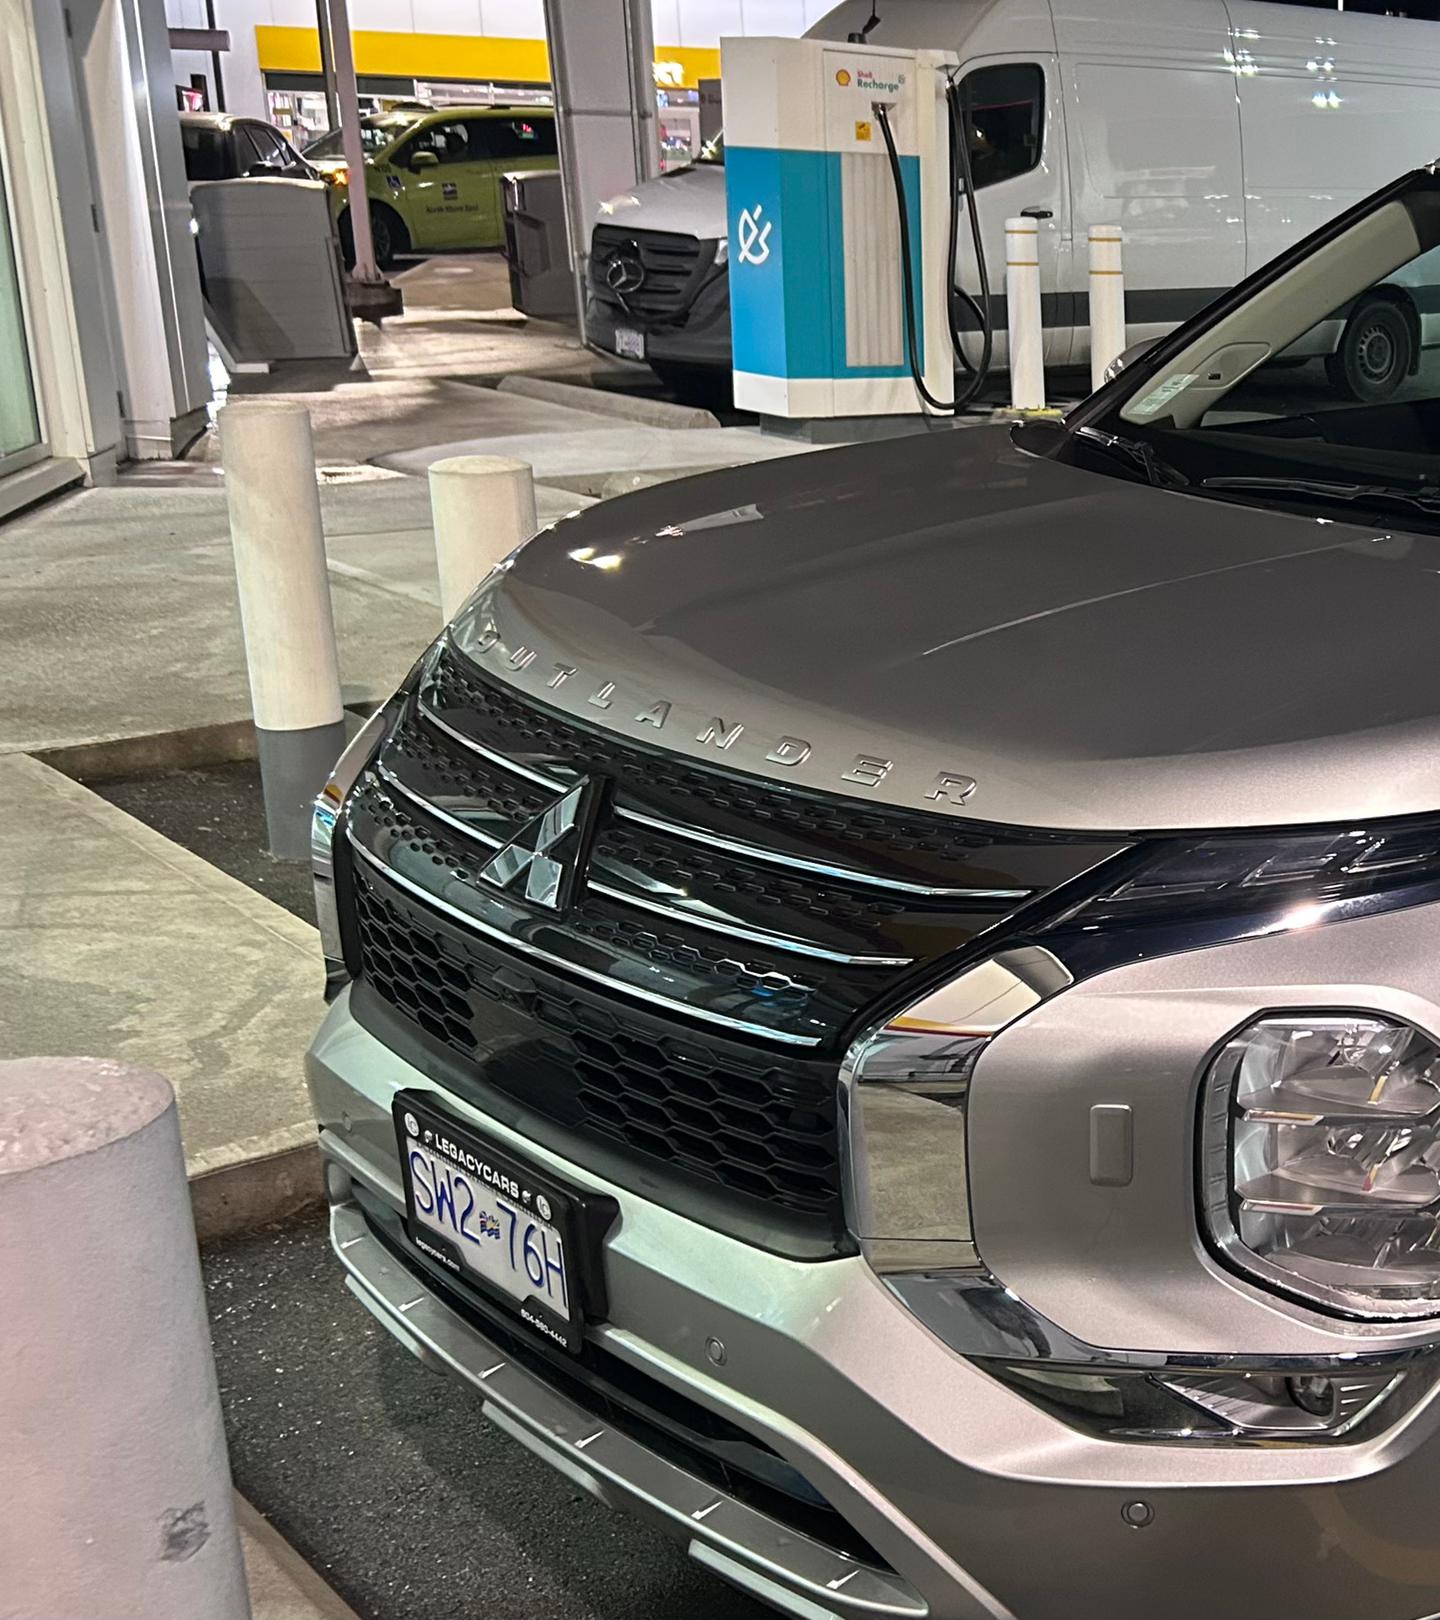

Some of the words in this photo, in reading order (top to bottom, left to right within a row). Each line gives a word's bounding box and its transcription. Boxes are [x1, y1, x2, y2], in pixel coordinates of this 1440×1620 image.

[857, 70, 873, 78] Shell
[857, 79, 899, 93] Recharge
[477, 630, 977, 806] OUTLANDER
[435, 1133, 519, 1199] LEGACYCARS
[410, 1151, 481, 1246] SW2
[497, 1200, 568, 1309] 76H
